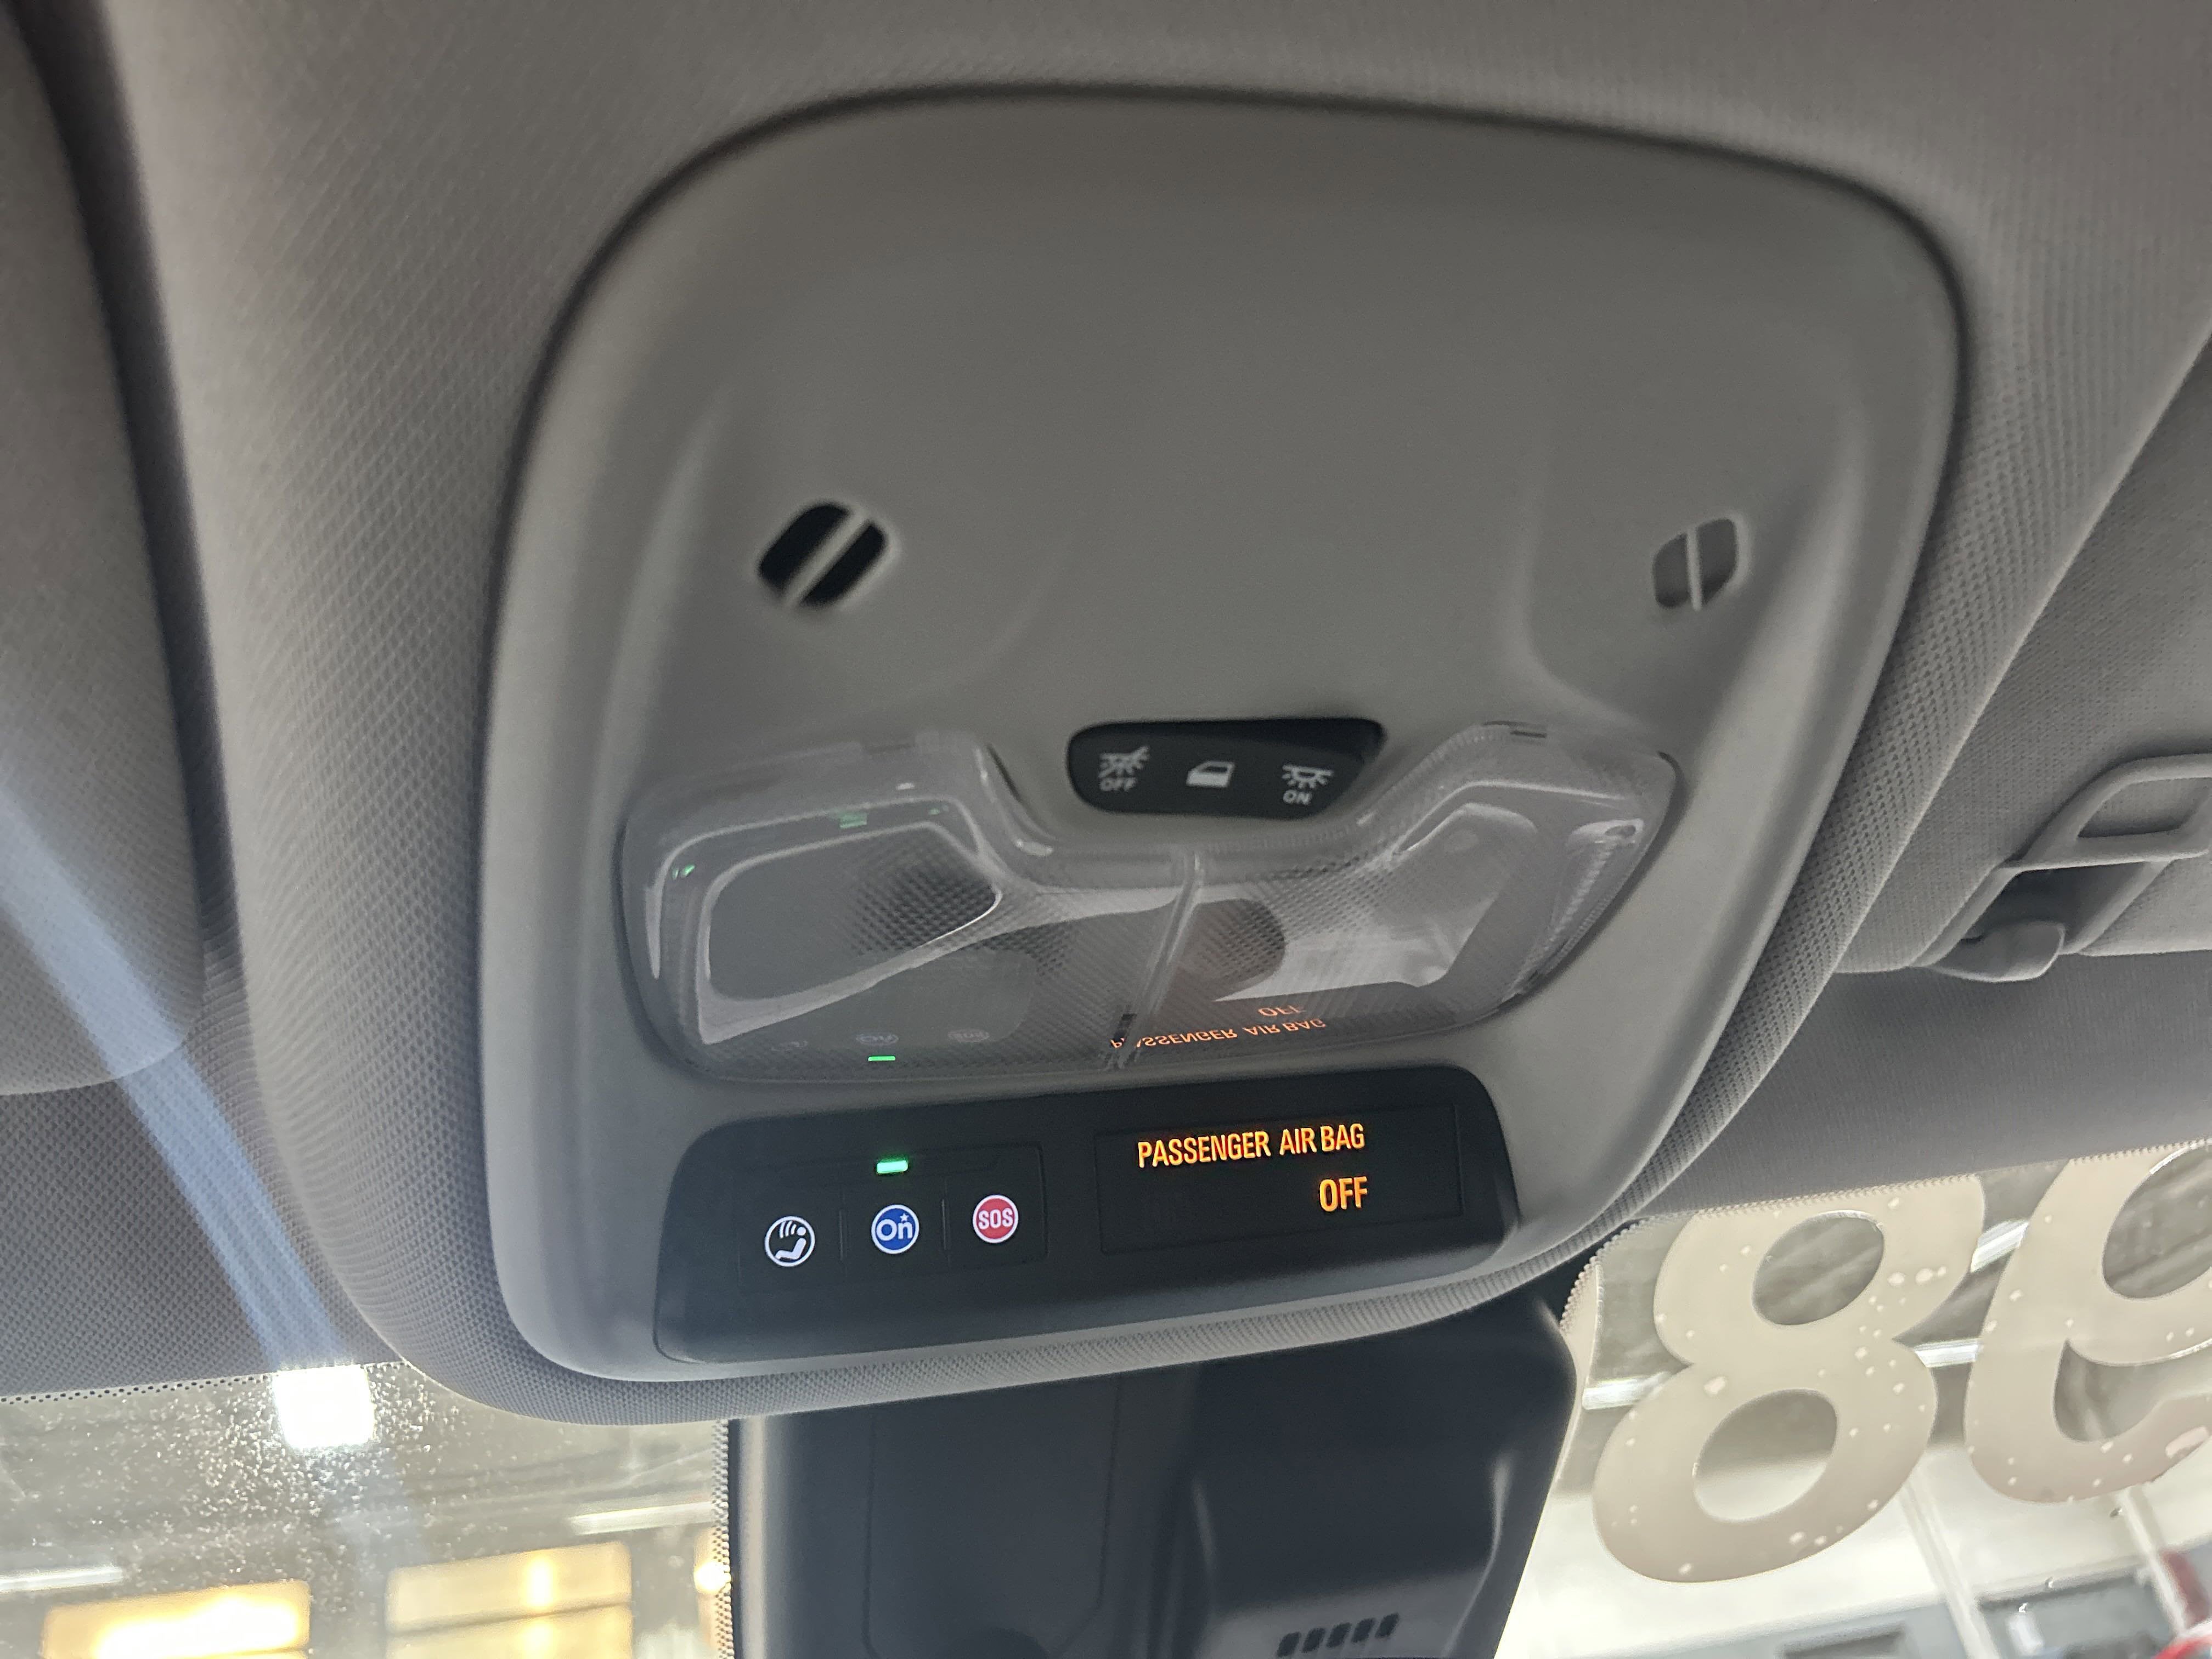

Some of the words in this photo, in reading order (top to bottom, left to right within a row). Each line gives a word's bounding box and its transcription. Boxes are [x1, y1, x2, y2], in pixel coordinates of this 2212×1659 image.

[1099, 777, 1137, 792] OFF
[1283, 790, 1312, 805] ON
[1137, 1131, 1271, 1168] PASSENGER
[1279, 1127, 1317, 1156] AIR
[1320, 1123, 1365, 1152] BAG
[1319, 1176, 1368, 1212] OFF
[878, 1216, 913, 1242] On
[978, 1208, 1014, 1230] SOS
